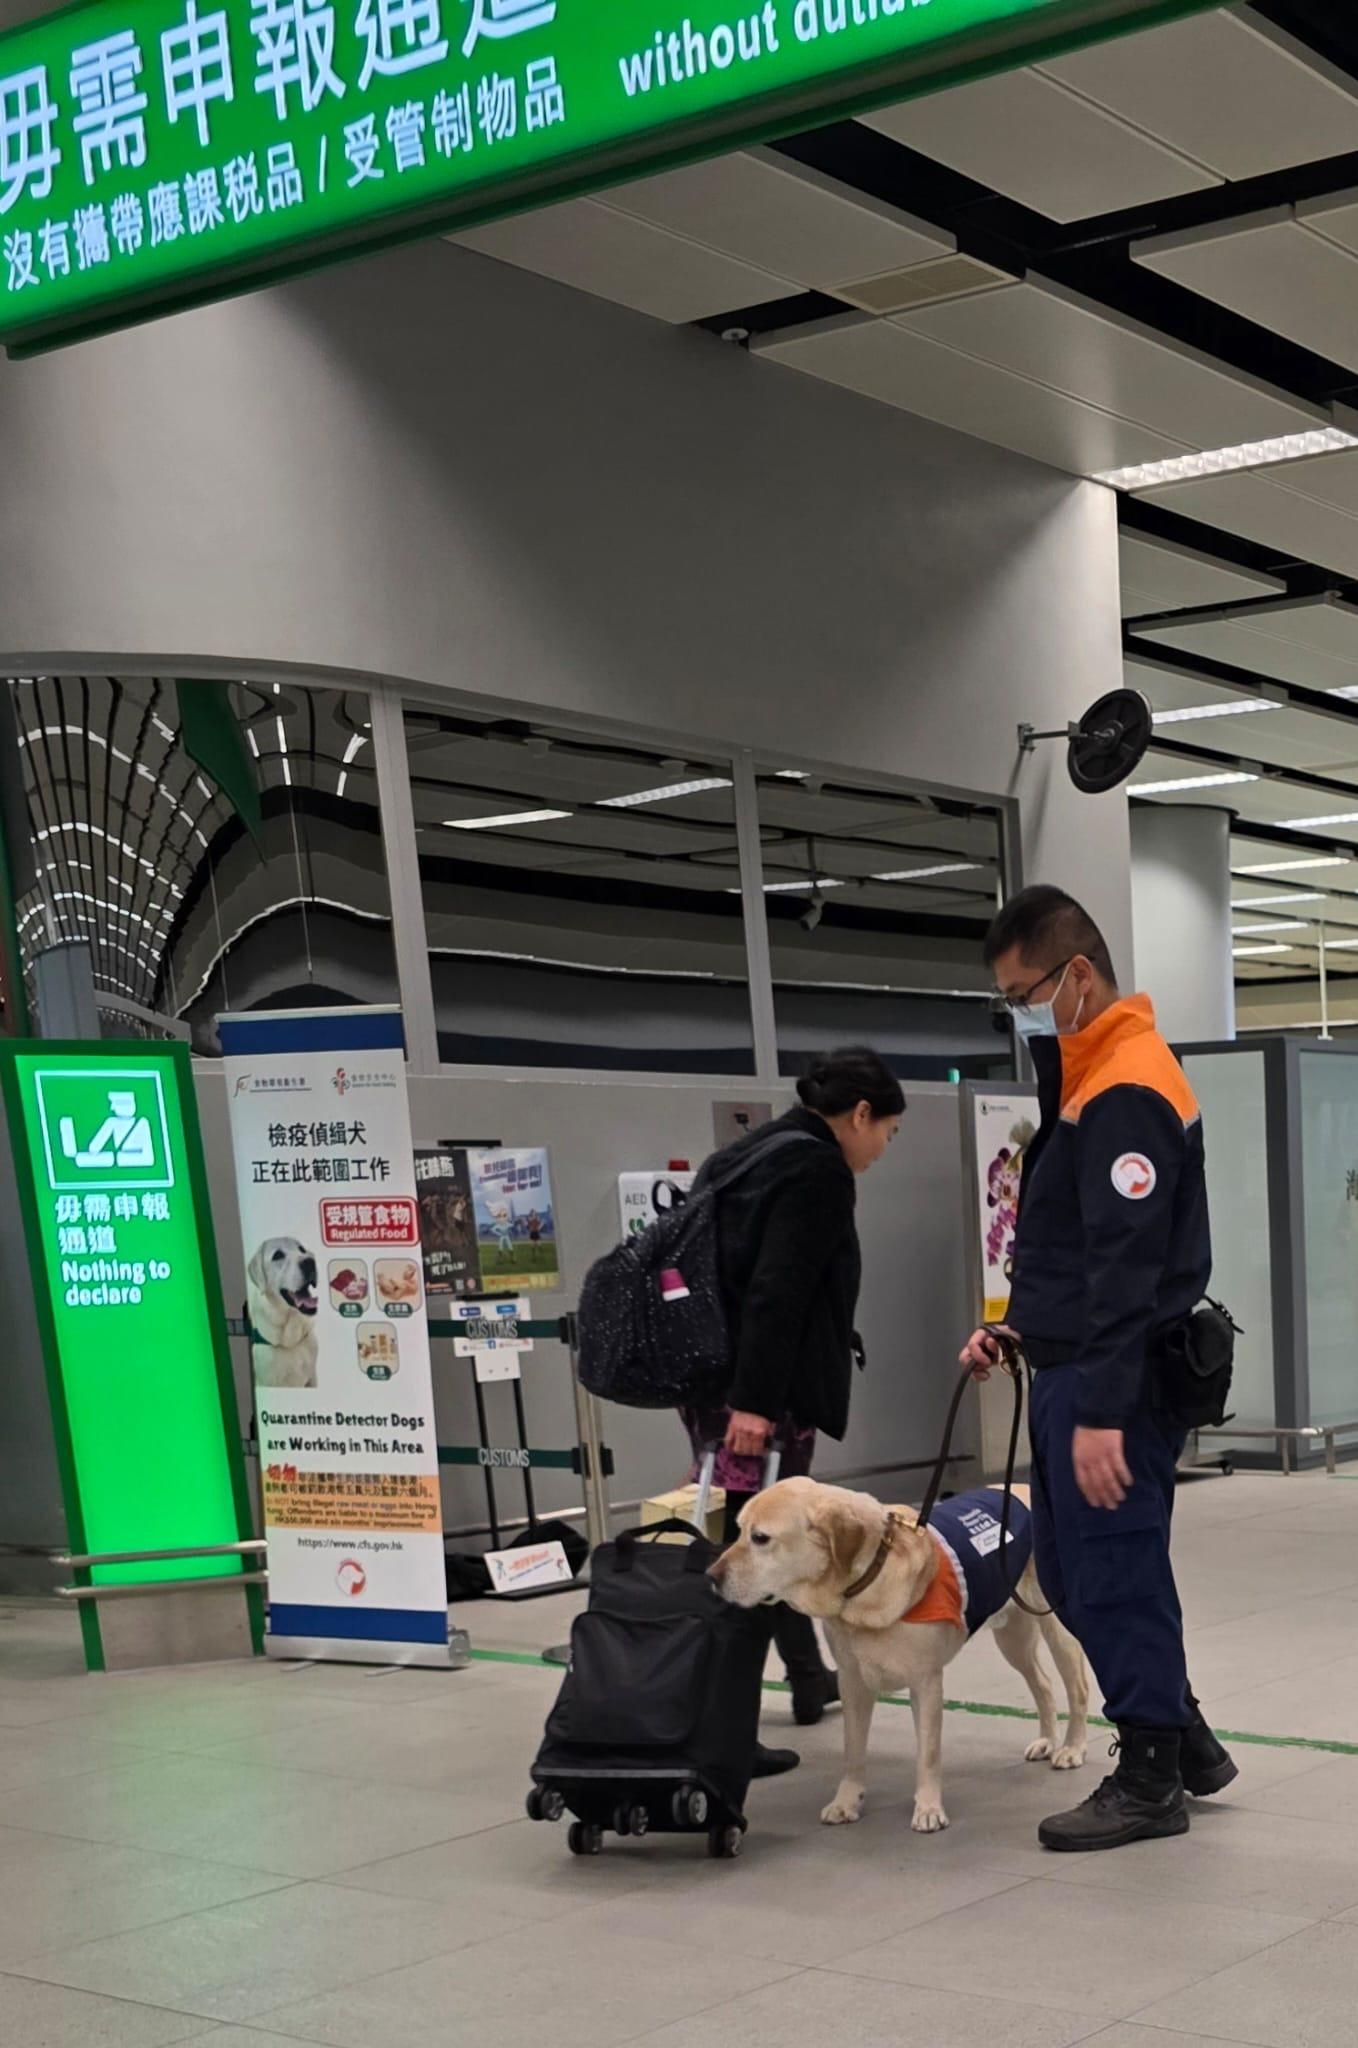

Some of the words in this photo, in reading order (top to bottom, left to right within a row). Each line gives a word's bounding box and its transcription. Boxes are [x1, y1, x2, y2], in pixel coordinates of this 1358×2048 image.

[618, 0, 780, 97] without
[344, 56, 565, 189] 受管制物品
[268, 1120, 367, 1148] 檢疫偵緝犬
[251, 1157, 391, 1184] 正在此範圍工作
[55, 1192, 170, 1223] 毋需申報
[625, 1193, 647, 1205] AED
[326, 1205, 411, 1227] 受規管食物
[58, 1226, 117, 1255] 通道
[330, 1228, 378, 1241] Regulated
[379, 1227, 408, 1239] Food
[61, 1259, 145, 1285] Nothing
[149, 1260, 170, 1279] to
[65, 1284, 142, 1306] declare
[465, 1319, 519, 1339] CUSTOMS
[261, 1411, 332, 1427] Quarantine
[335, 1411, 388, 1428] Detector
[391, 1413, 425, 1431] Dogs
[268, 1439, 286, 1450] are
[288, 1437, 347, 1455] Working
[349, 1438, 361, 1452] in
[363, 1438, 389, 1454] This
[391, 1439, 424, 1454] Area
[477, 1448, 530, 1468] CUSTOMS
[297, 1537, 404, 1552] https://www.cfs.gov.hk
